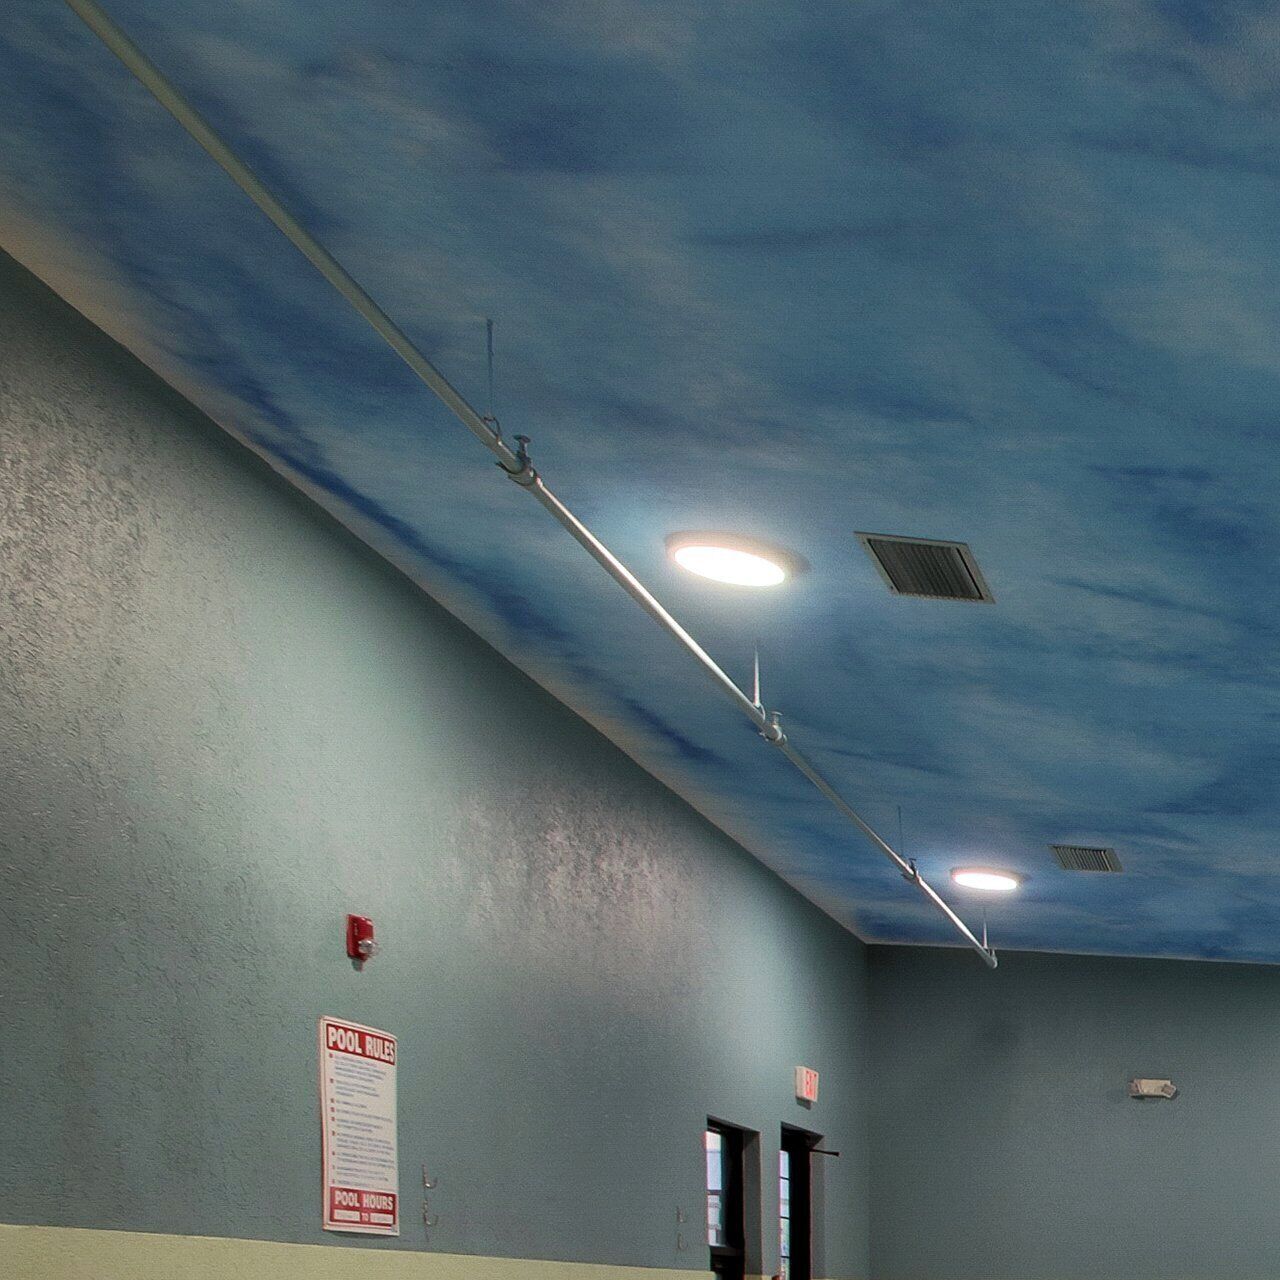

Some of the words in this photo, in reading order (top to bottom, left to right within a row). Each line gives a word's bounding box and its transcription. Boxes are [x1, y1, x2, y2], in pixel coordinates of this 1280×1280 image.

[329, 1026, 361, 1054] POOL
[365, 1036, 395, 1063] RULES
[334, 1190, 361, 1207] POOL
[363, 1193, 393, 1211] HOURS
